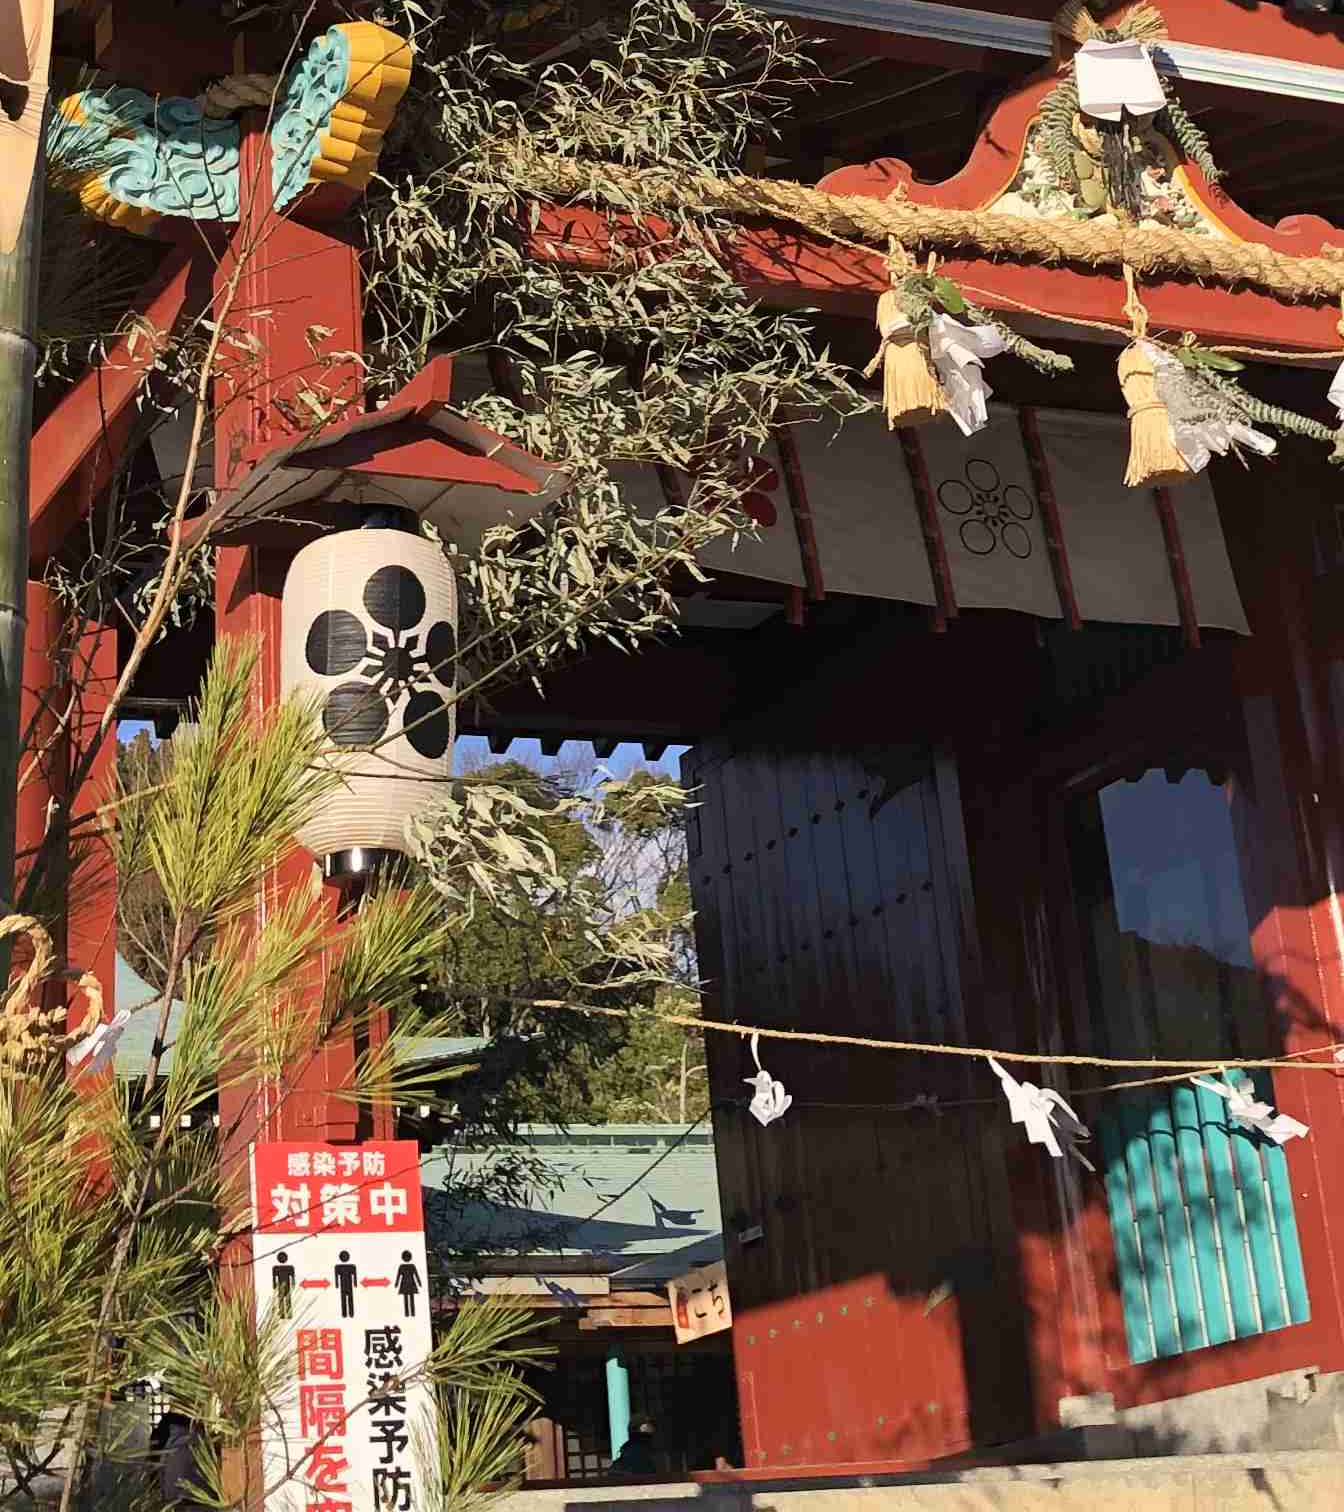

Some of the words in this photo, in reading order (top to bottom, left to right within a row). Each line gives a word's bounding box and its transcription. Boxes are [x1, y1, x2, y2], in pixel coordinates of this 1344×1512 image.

[270, 1183, 408, 1226] 対策中
[287, 1152, 386, 1177] 感染予防
[296, 1328, 353, 1512] 間隔を
[364, 1325, 411, 1512] 感染予防
